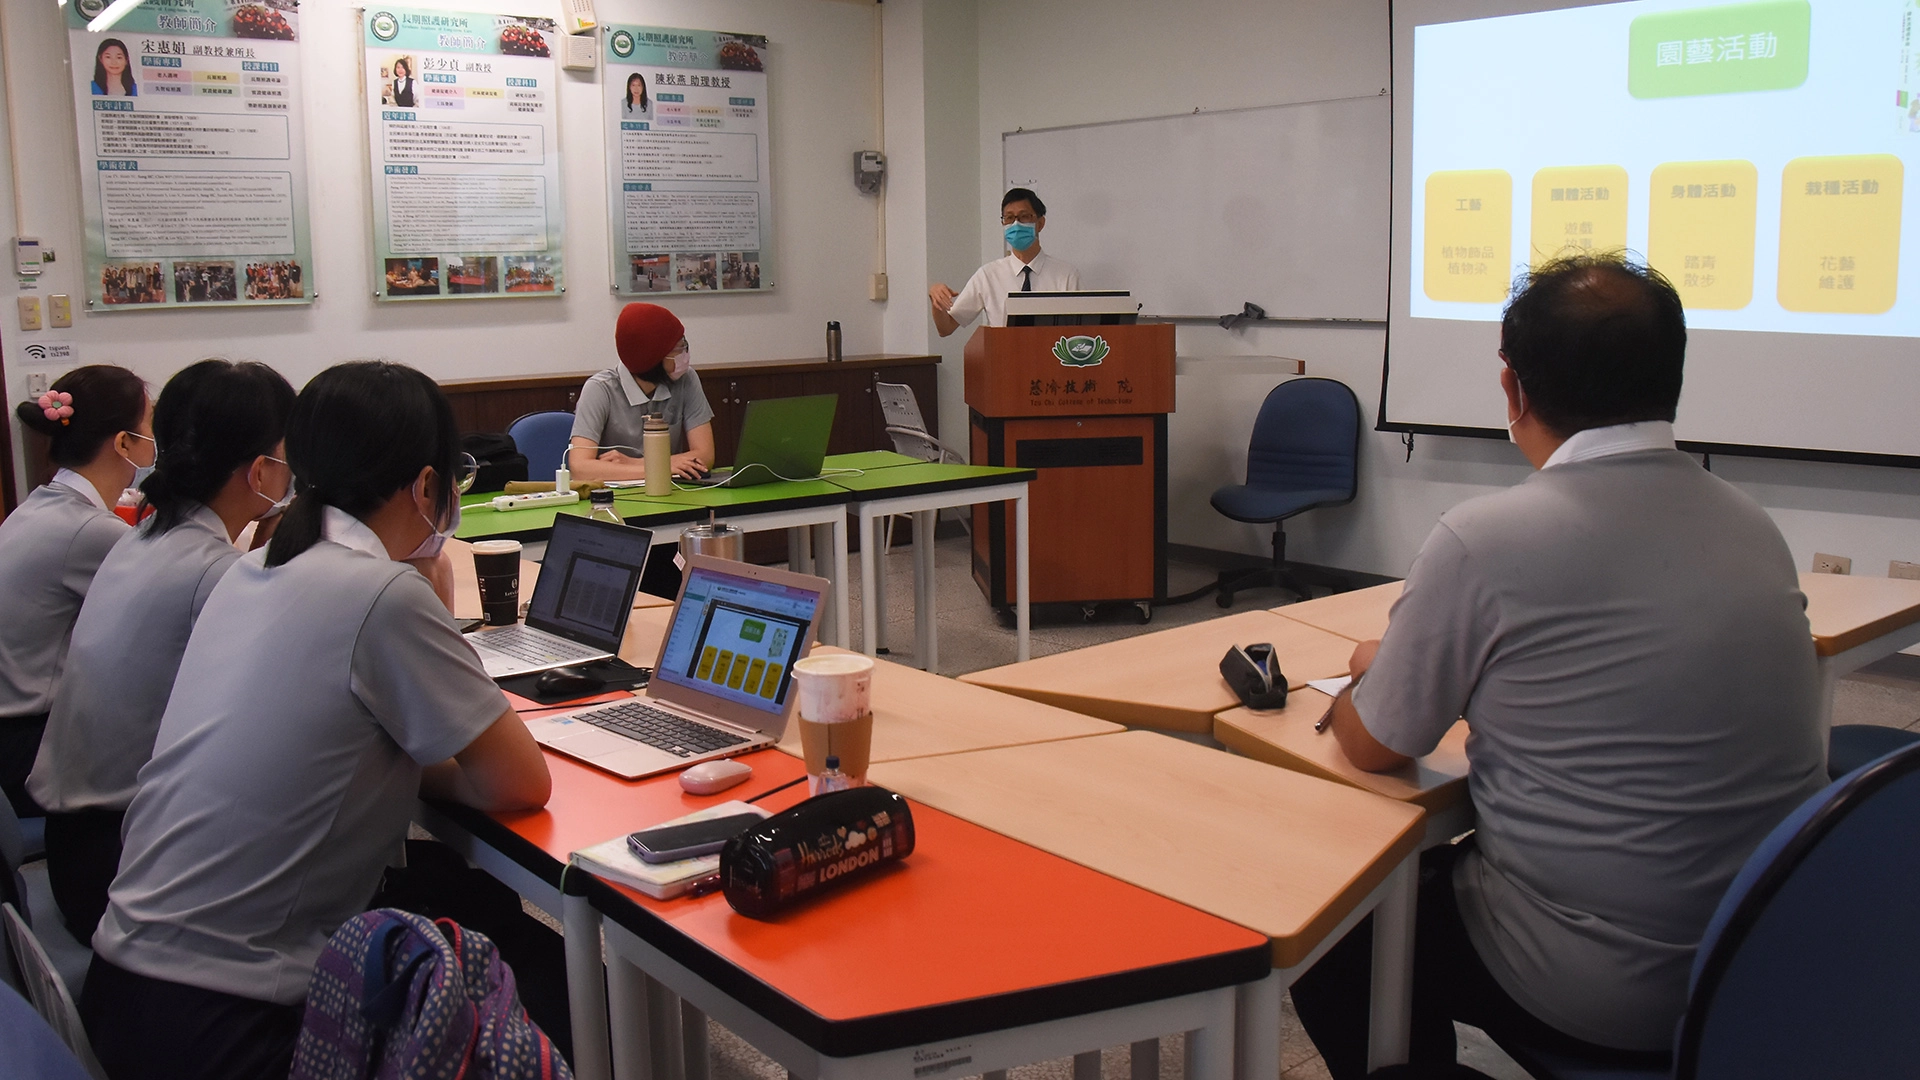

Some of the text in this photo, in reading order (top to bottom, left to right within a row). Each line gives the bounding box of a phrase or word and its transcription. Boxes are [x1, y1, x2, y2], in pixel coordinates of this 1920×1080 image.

[158, 14, 217, 33] 教師簡介
[402, 13, 468, 28] 長期照護研究所
[439, 35, 486, 50] 教師簡介
[637, 32, 694, 45] 長期照護研究所
[141, 39, 256, 59] 宋惠娟 副教授兼所長
[1656, 31, 1778, 68] 園藝活動
[142, 57, 180, 67] 學術專長
[244, 61, 278, 71] 授課科目
[423, 58, 492, 73] 彭少貞 副教授
[655, 73, 731, 88] 陳秋燕 助理教授
[94, 101, 133, 110] 近年計畫
[99, 161, 136, 170] 學術發表
[1550, 187, 1610, 202] 團體活動
[1670, 183, 1737, 199] 身體活動
[1804, 179, 1879, 196] 栽種活動
[1455, 198, 1482, 211] 工藝
[1564, 221, 1593, 236] 遊戲
[1442, 245, 1495, 260] 植物飾品
[1447, 261, 1488, 275] 植物染
[1684, 255, 1717, 270] 踏青
[1819, 256, 1856, 272] 花藝
[1683, 273, 1717, 288] 散步
[1818, 274, 1855, 291] 維護
[820, 846, 880, 883] LONDON
